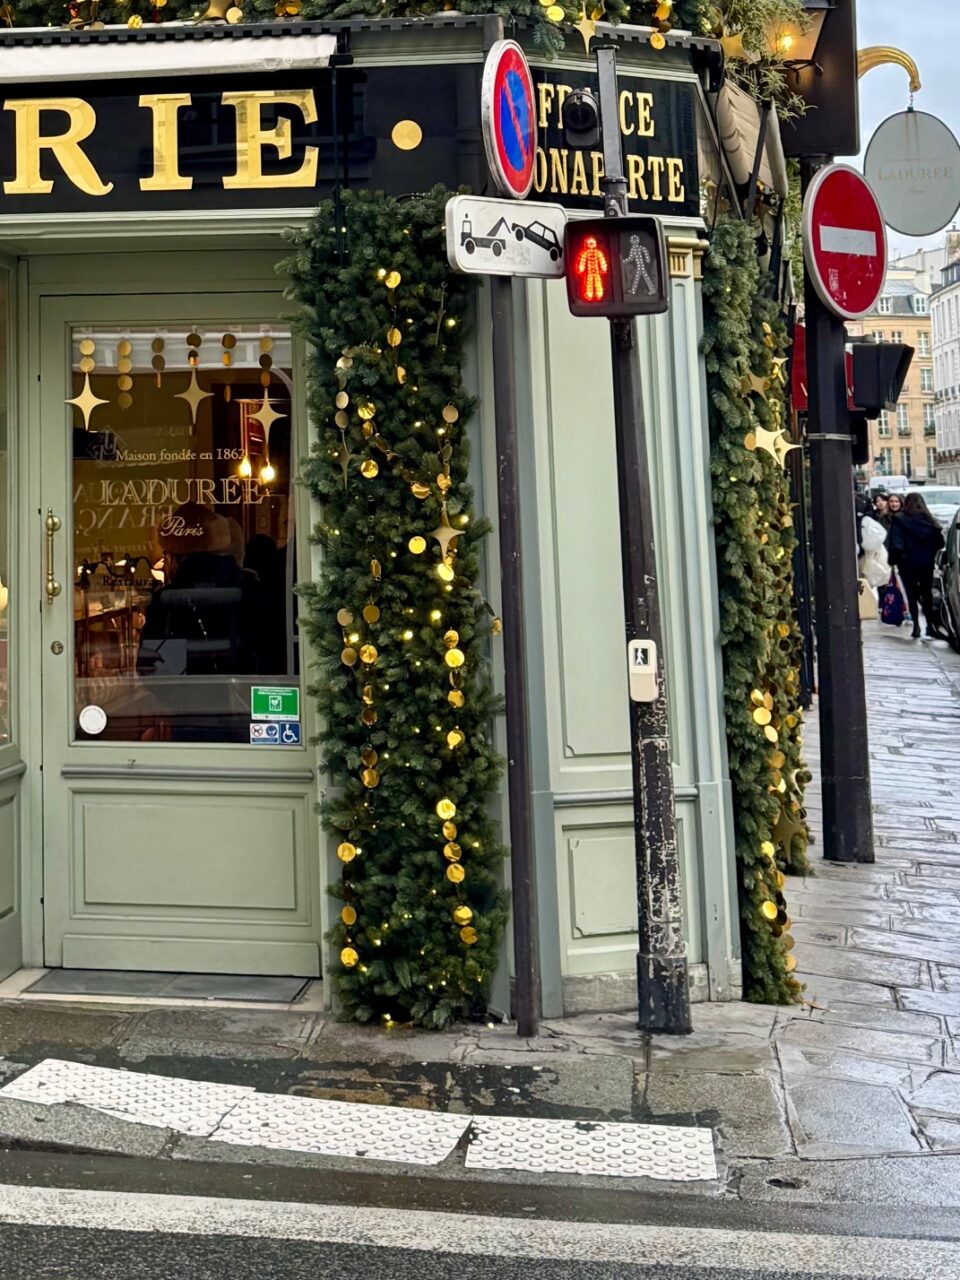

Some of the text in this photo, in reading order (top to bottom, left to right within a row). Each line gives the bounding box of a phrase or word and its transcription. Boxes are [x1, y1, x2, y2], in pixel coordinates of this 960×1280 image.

[537, 82, 655, 137] FCE
[533, 147, 685, 203] ONAPRTE
[114, 447, 246, 462] Maison fondée en 1862
[99, 474, 265, 505] LADURÉE
[160, 516, 205, 538] Paris
